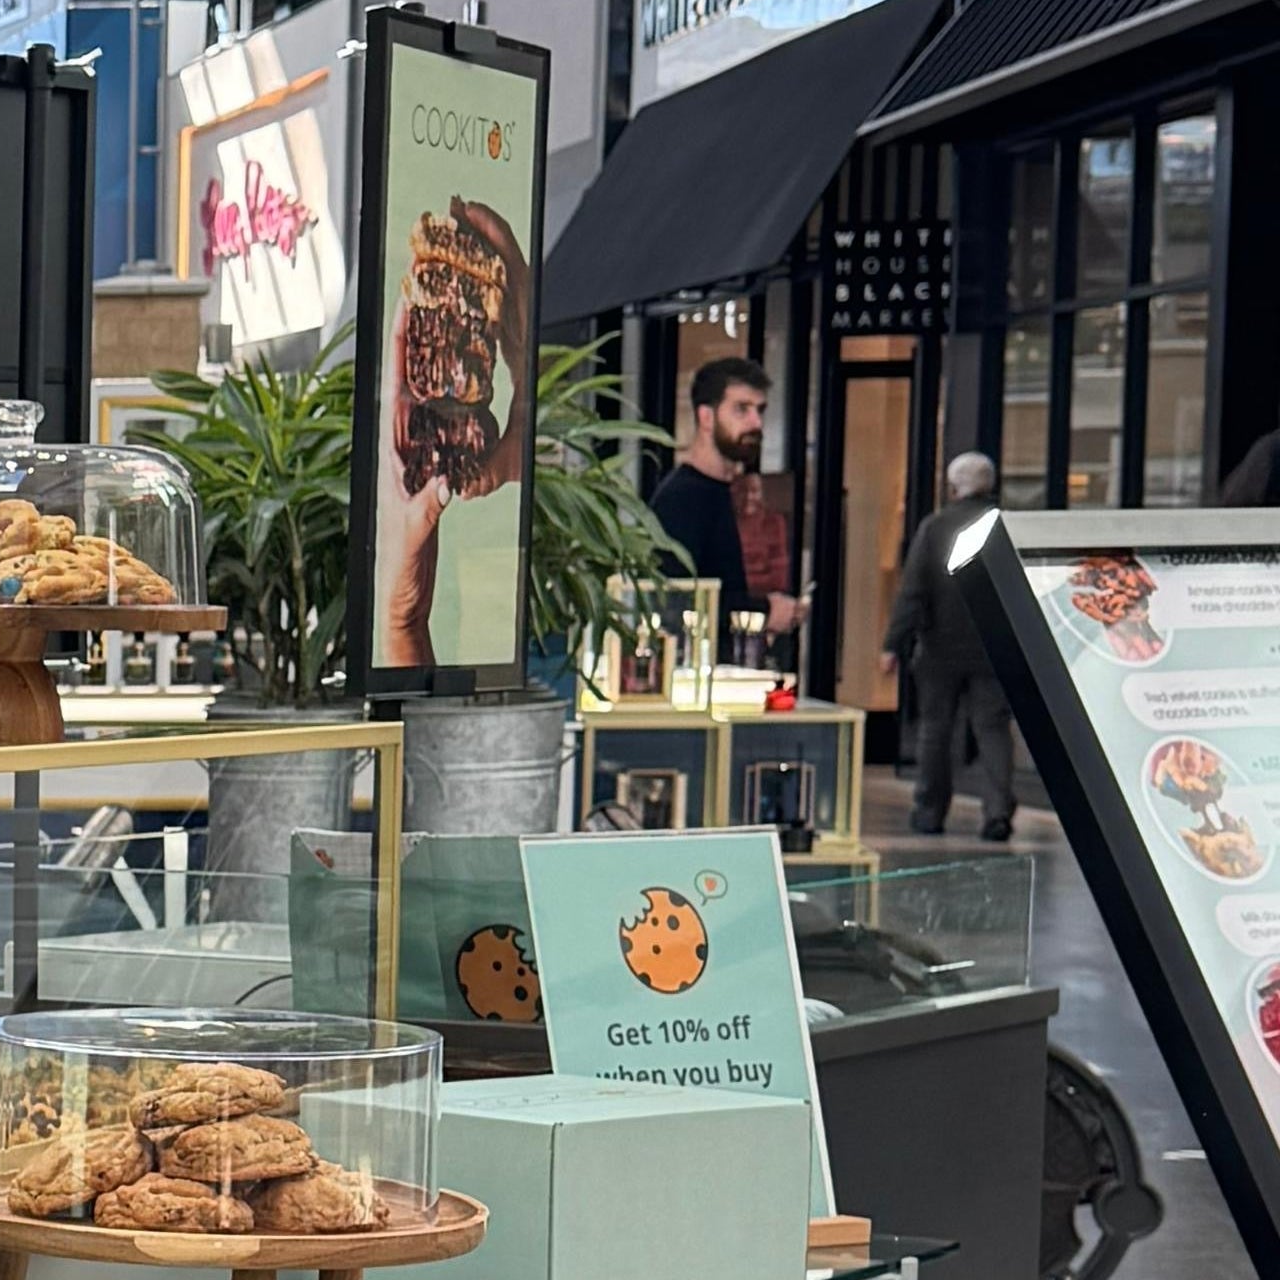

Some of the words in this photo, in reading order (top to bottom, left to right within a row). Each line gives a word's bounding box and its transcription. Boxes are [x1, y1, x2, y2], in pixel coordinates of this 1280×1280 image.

[607, 1022, 652, 1046] Get
[658, 1018, 710, 1043] 10%
[716, 1014, 751, 1040] off
[673, 1066, 720, 1086] you
[726, 1058, 773, 1089] buy
